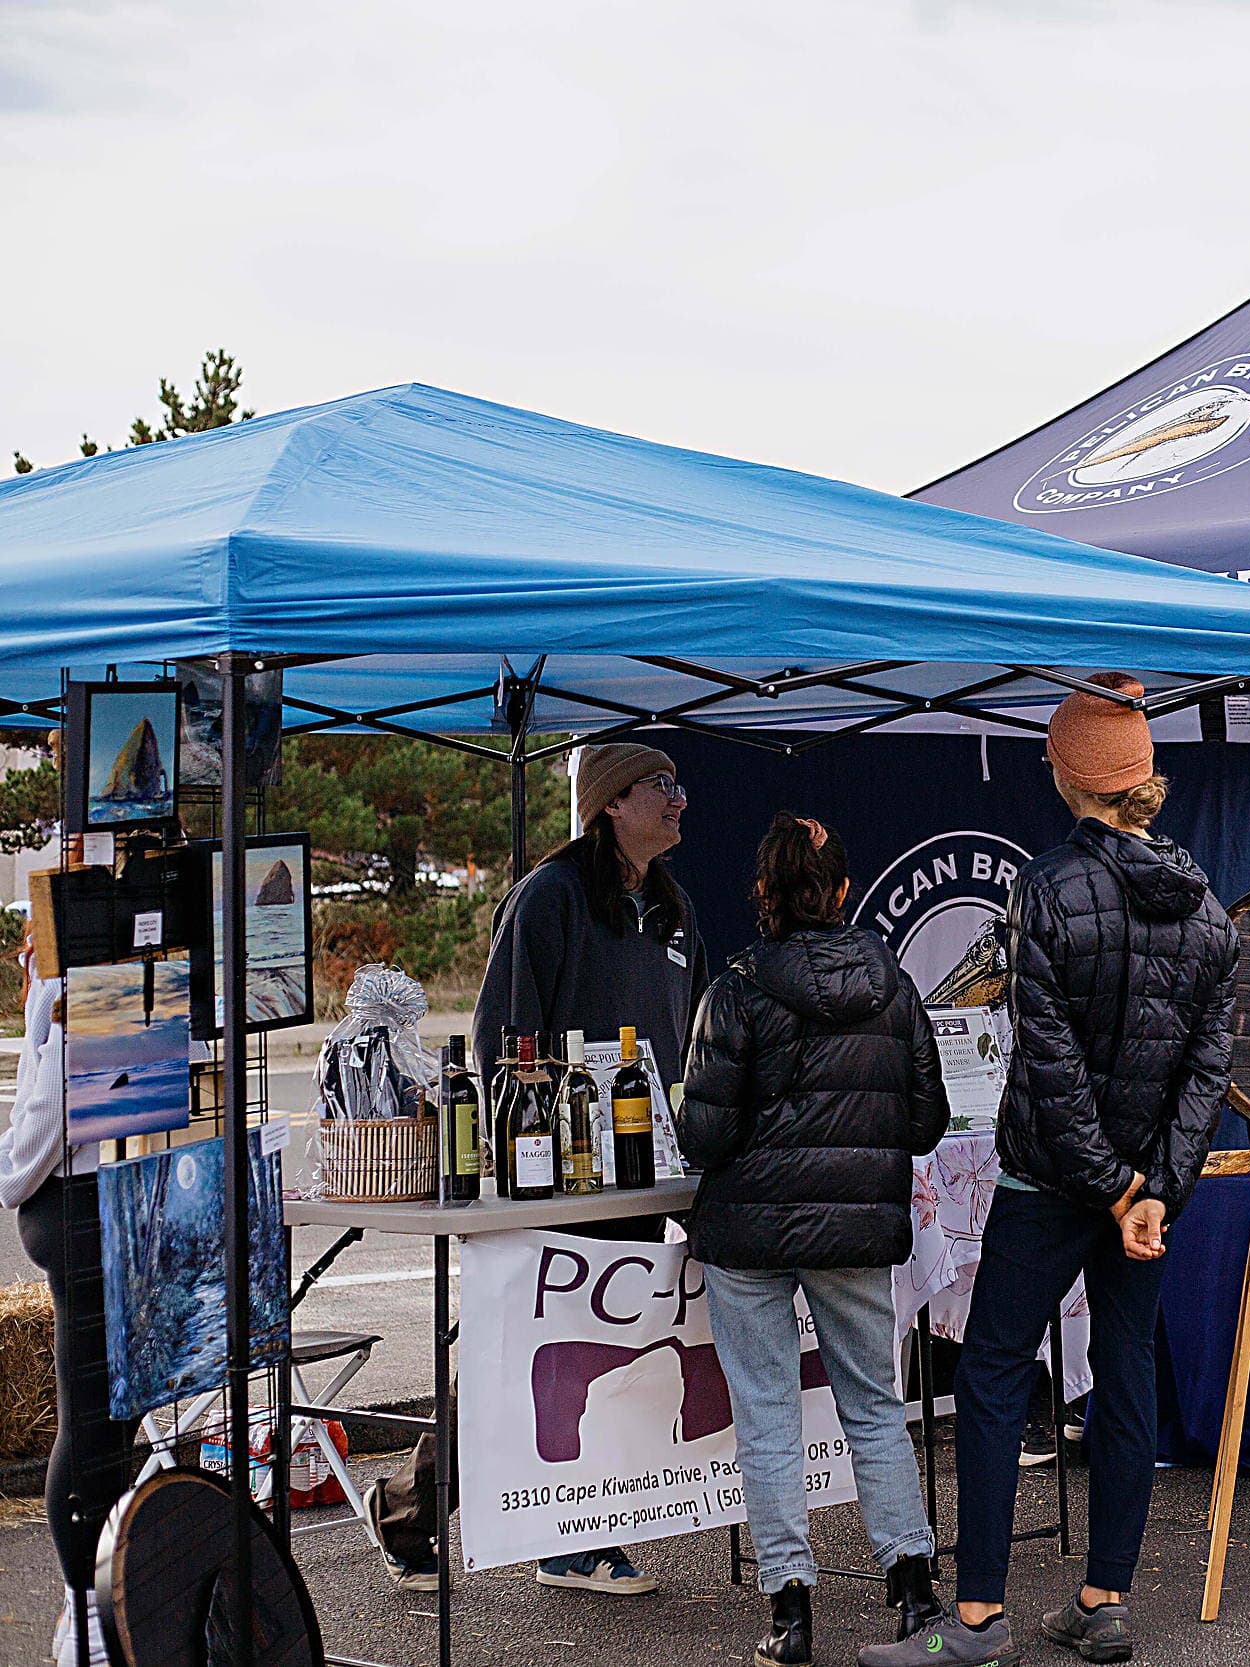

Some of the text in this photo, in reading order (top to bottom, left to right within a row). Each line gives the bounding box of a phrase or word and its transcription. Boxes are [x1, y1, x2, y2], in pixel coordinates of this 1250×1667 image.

[1059, 368, 1219, 464] PELICAN
[1035, 472, 1186, 506] COMPANY
[875, 853, 958, 942] ICAN
[501, 1486, 550, 1512] 33310
[555, 1484, 597, 1505] Cape
[601, 1471, 660, 1497] Kiwanda
[662, 1467, 708, 1489] Drive,
[808, 1441, 830, 1461] OR
[557, 1498, 698, 1536] www-pc-pour.com
